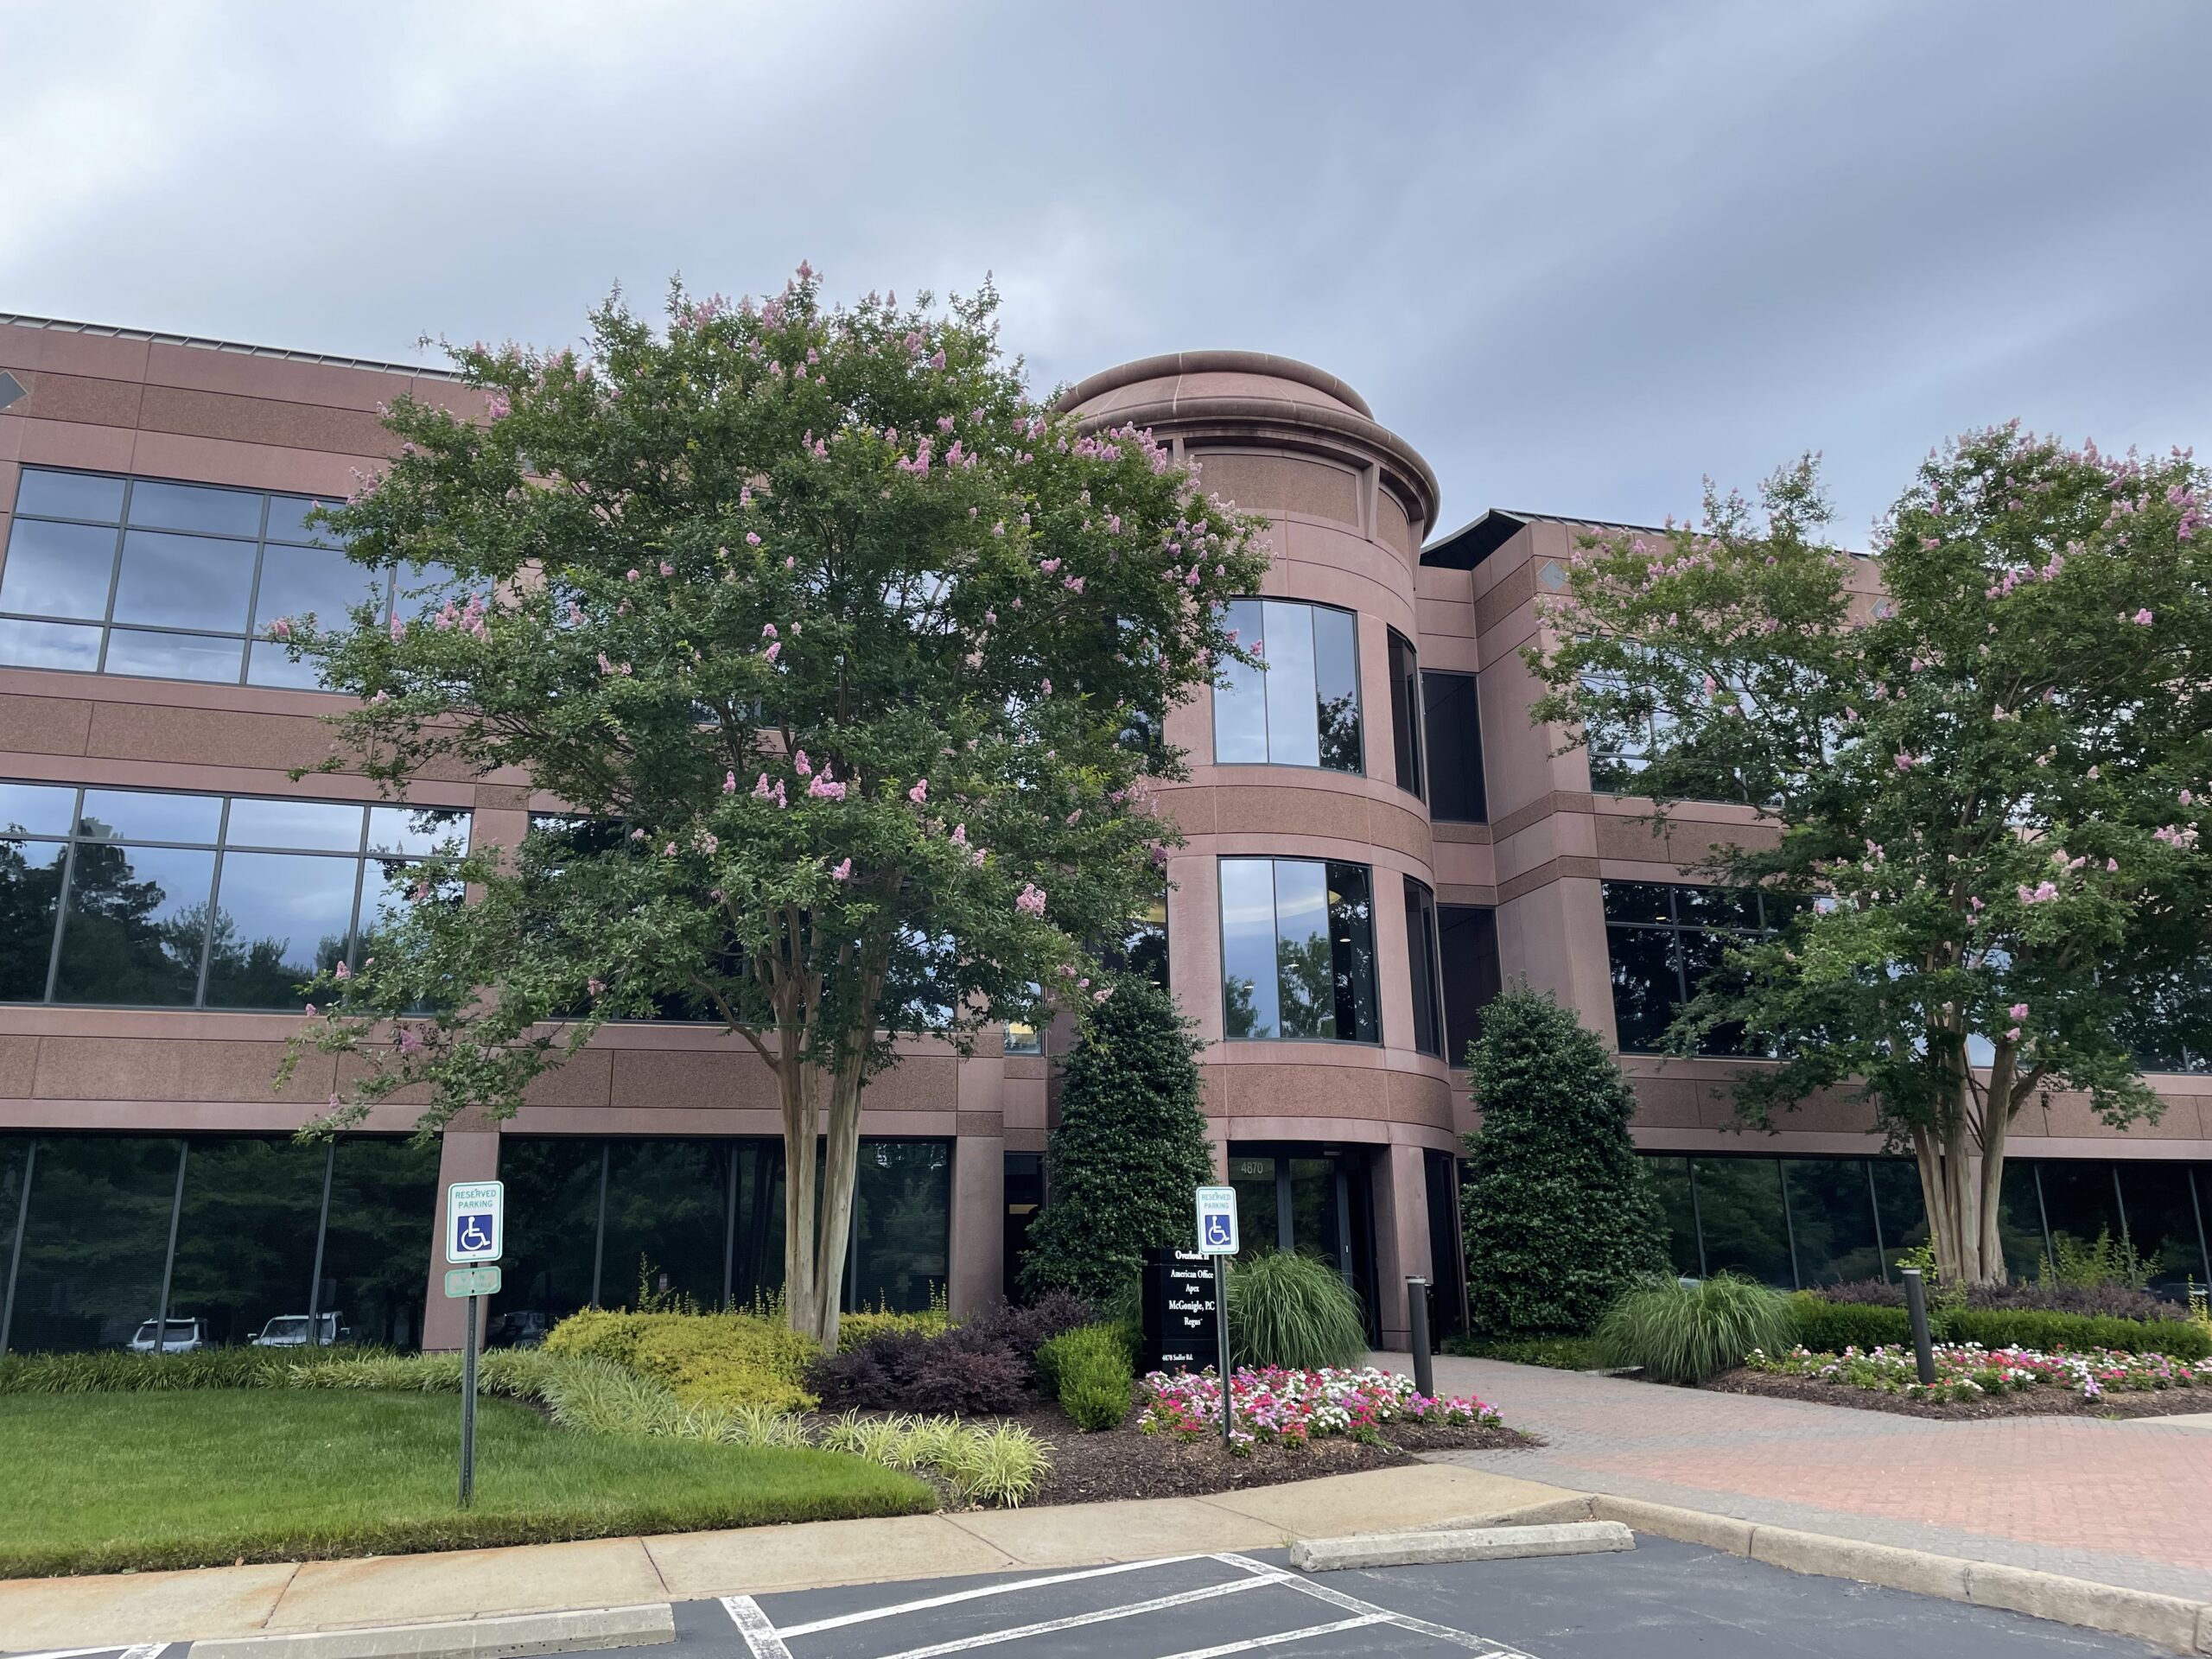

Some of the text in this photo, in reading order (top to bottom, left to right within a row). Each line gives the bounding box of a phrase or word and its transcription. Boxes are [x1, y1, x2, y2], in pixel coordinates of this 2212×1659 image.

[1241, 1161, 1263, 1174] 4870
[455, 1189, 497, 1199] RESERVED
[458, 1199, 493, 1209] PARKING
[1170, 1268, 1214, 1279] American Office
[1185, 1283, 1199, 1294] Apex
